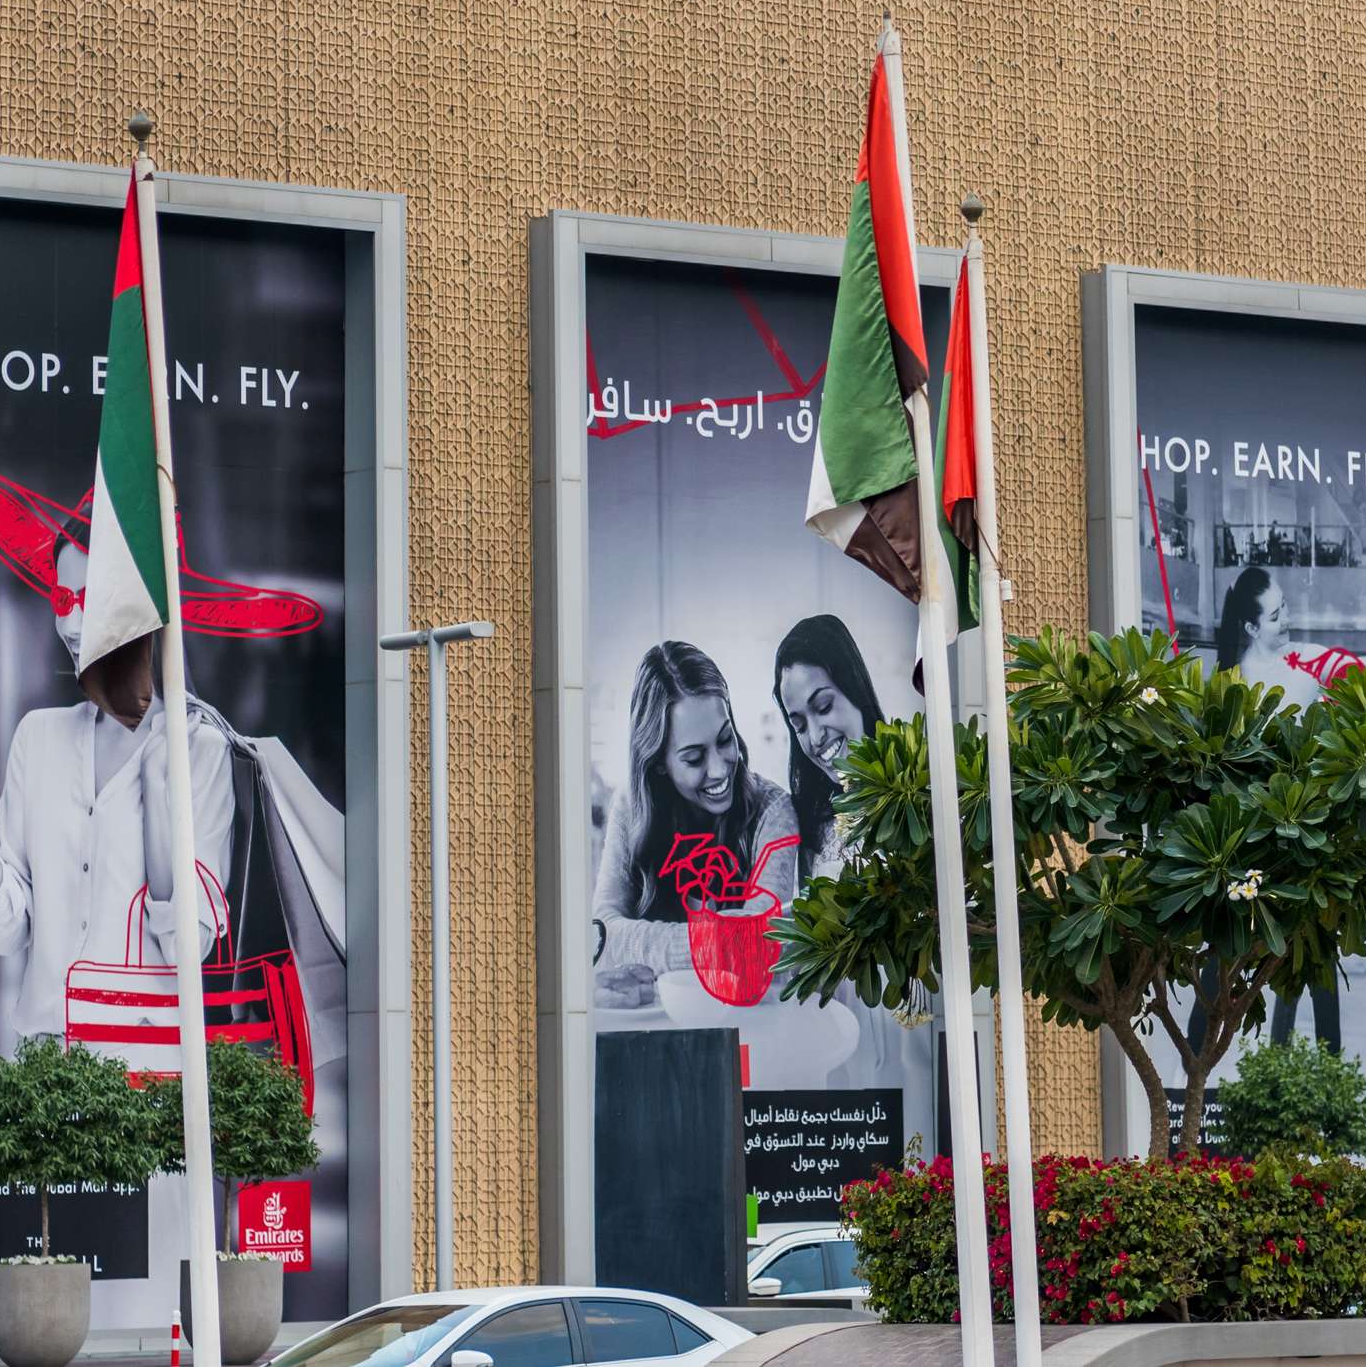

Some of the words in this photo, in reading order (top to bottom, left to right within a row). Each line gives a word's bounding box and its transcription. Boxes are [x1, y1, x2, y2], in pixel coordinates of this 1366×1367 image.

[92, 355, 219, 403] EN.
[239, 365, 309, 410] FLY.
[1140, 434, 1218, 476] HOP.
[1234, 441, 1332, 484] EARN.
[774, 1108, 799, 1122] نقاط
[801, 1110, 828, 1125] بجمع
[830, 1107, 865, 1122] نفسك
[743, 1133, 762, 1155] في
[806, 1134, 826, 1147] عند
[830, 1132, 855, 1150] واردز
[856, 1130, 889, 1153] سكاي
[817, 1158, 840, 1174] دبي
[772, 1190, 794, 1207] دبي
[795, 1186, 832, 1203] تطبيق
[244, 1227, 305, 1246] Emirates
